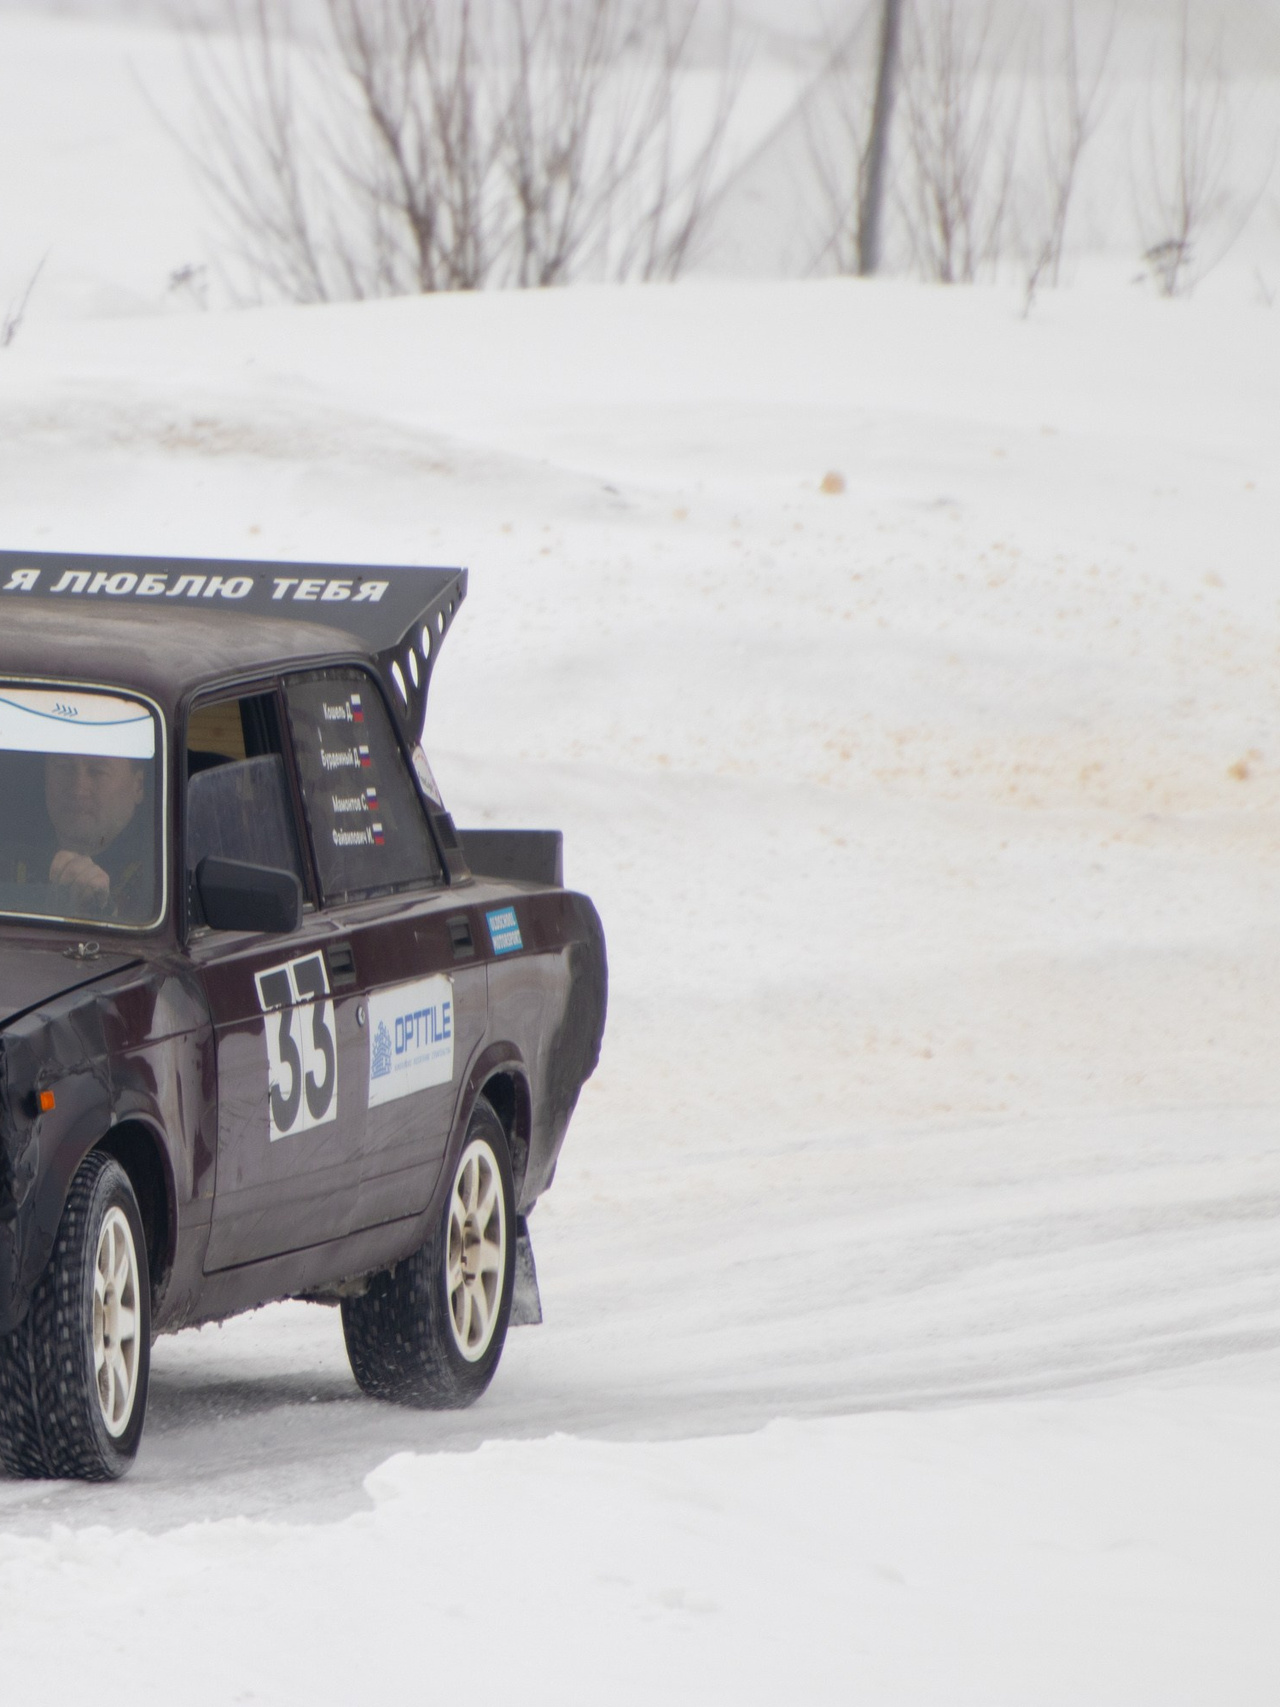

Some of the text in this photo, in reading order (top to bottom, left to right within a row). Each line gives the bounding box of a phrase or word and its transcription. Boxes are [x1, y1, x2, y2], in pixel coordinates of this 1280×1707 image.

[4, 569, 40, 591] Я
[50, 571, 254, 599] ЛЮБЛЮ
[271, 578, 389, 602] ТЕБЯ
[259, 956, 336, 1133] 33
[394, 1001, 451, 1055] OPTTILE
